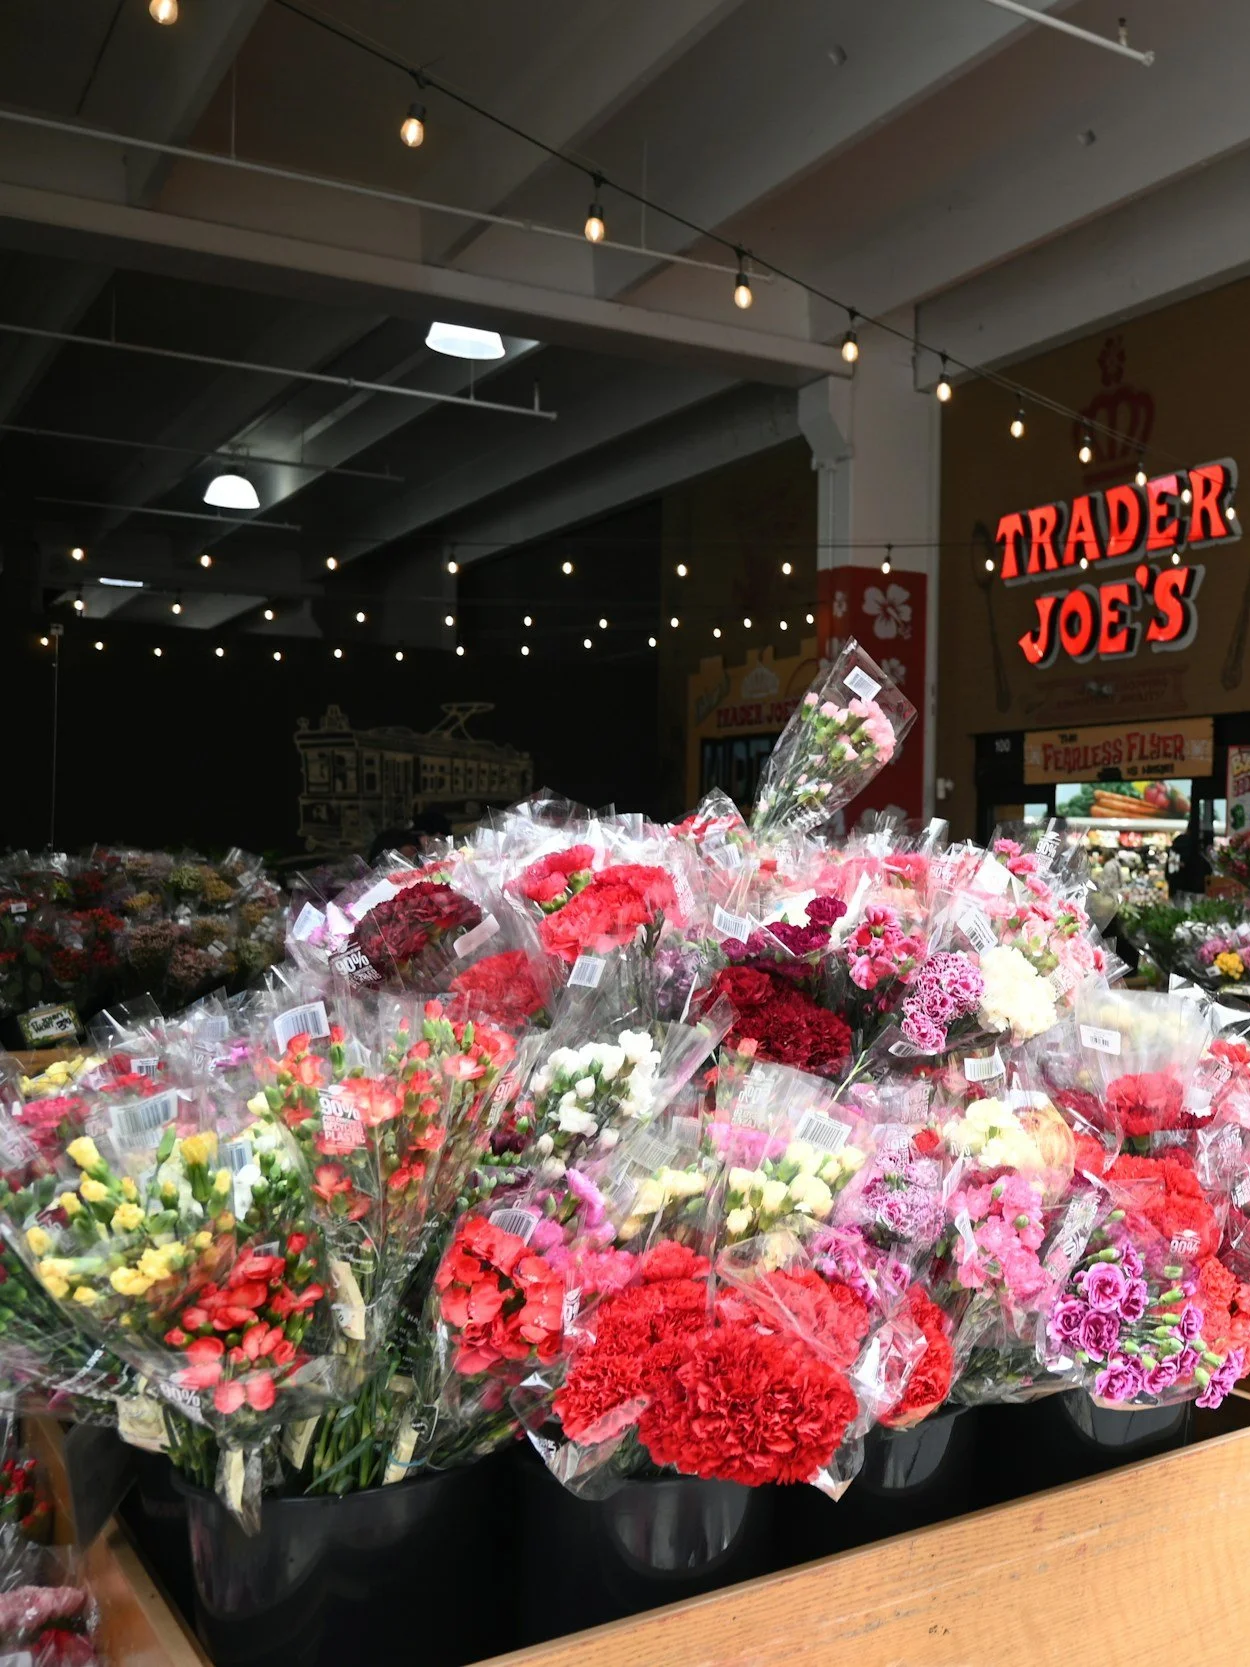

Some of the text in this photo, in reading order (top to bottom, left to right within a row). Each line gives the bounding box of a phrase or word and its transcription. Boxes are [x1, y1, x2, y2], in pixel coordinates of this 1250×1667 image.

[995, 462, 1234, 583] TRADER
[1018, 564, 1198, 667] JOE'S
[1042, 731, 1185, 773] FEARLESS FLYER
[1035, 839, 1057, 859] 90%
[335, 951, 370, 976] 90%
[319, 1096, 361, 1121] 90%
[1170, 1239, 1198, 1255] 90%
